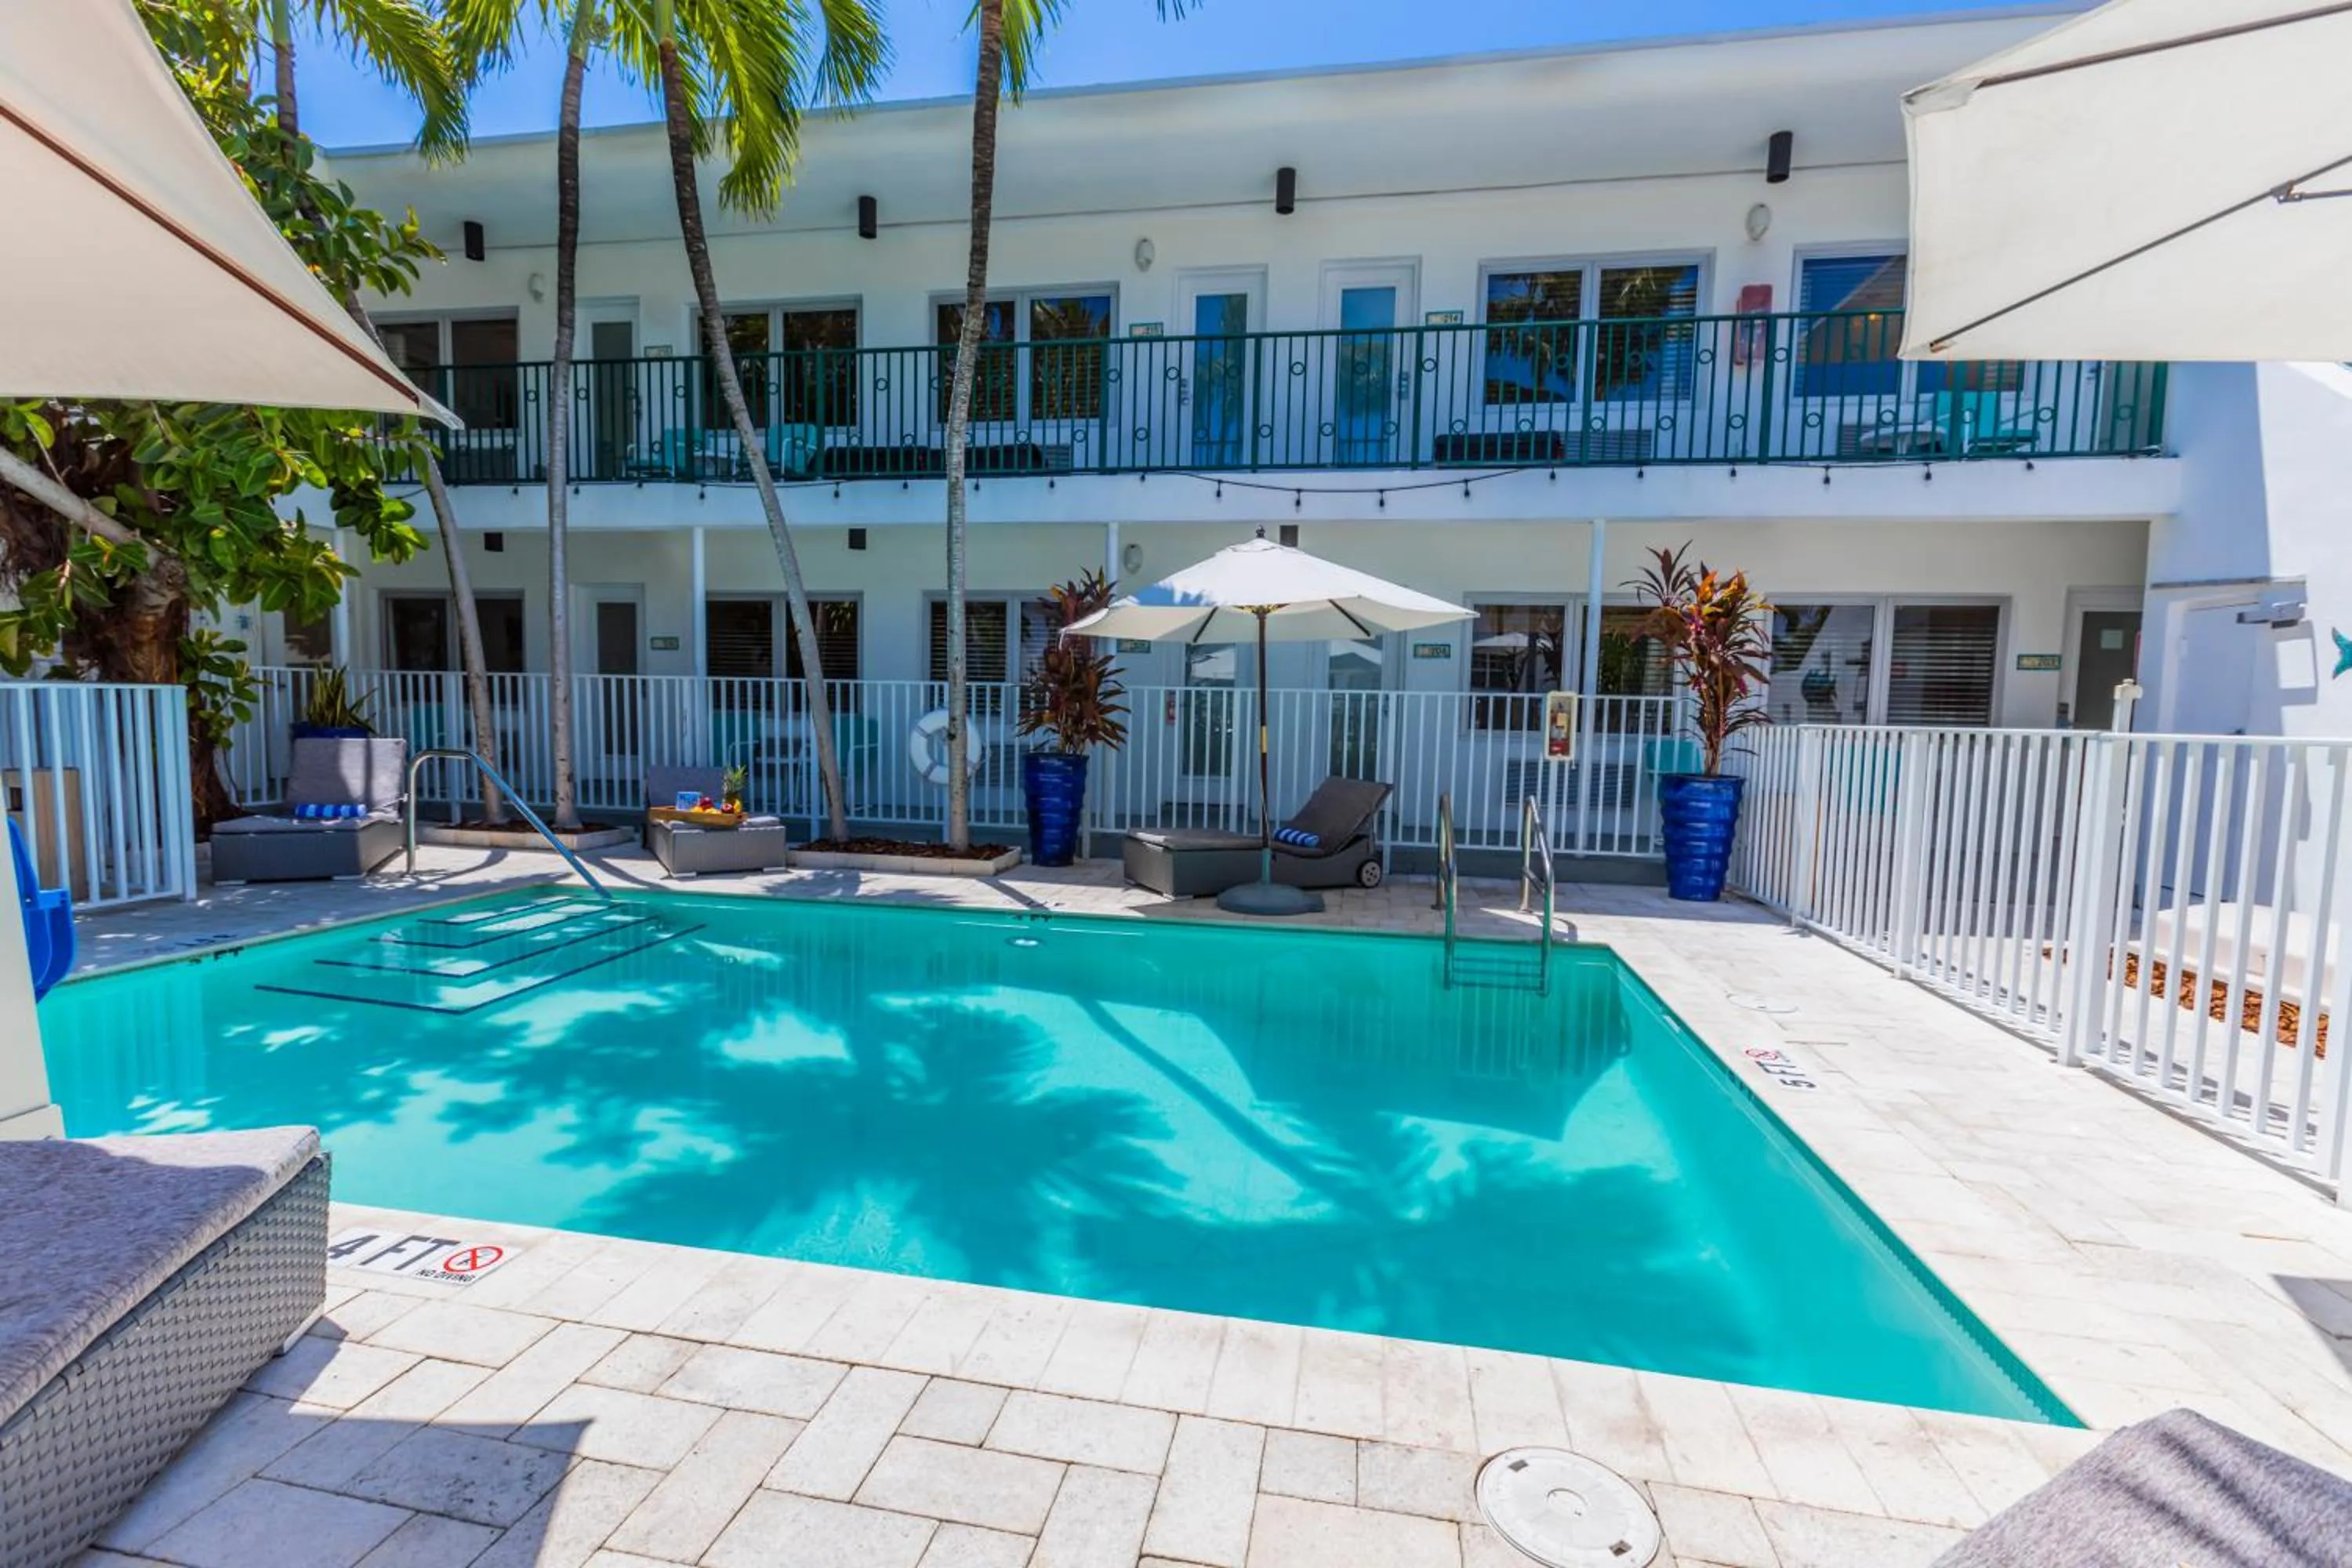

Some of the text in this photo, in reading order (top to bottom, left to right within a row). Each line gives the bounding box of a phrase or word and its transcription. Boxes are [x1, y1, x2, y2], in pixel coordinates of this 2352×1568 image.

[212, 946, 245, 961] FT
[328, 1234, 462, 1271] 4 FT
[415, 1269, 439, 1278] NO
